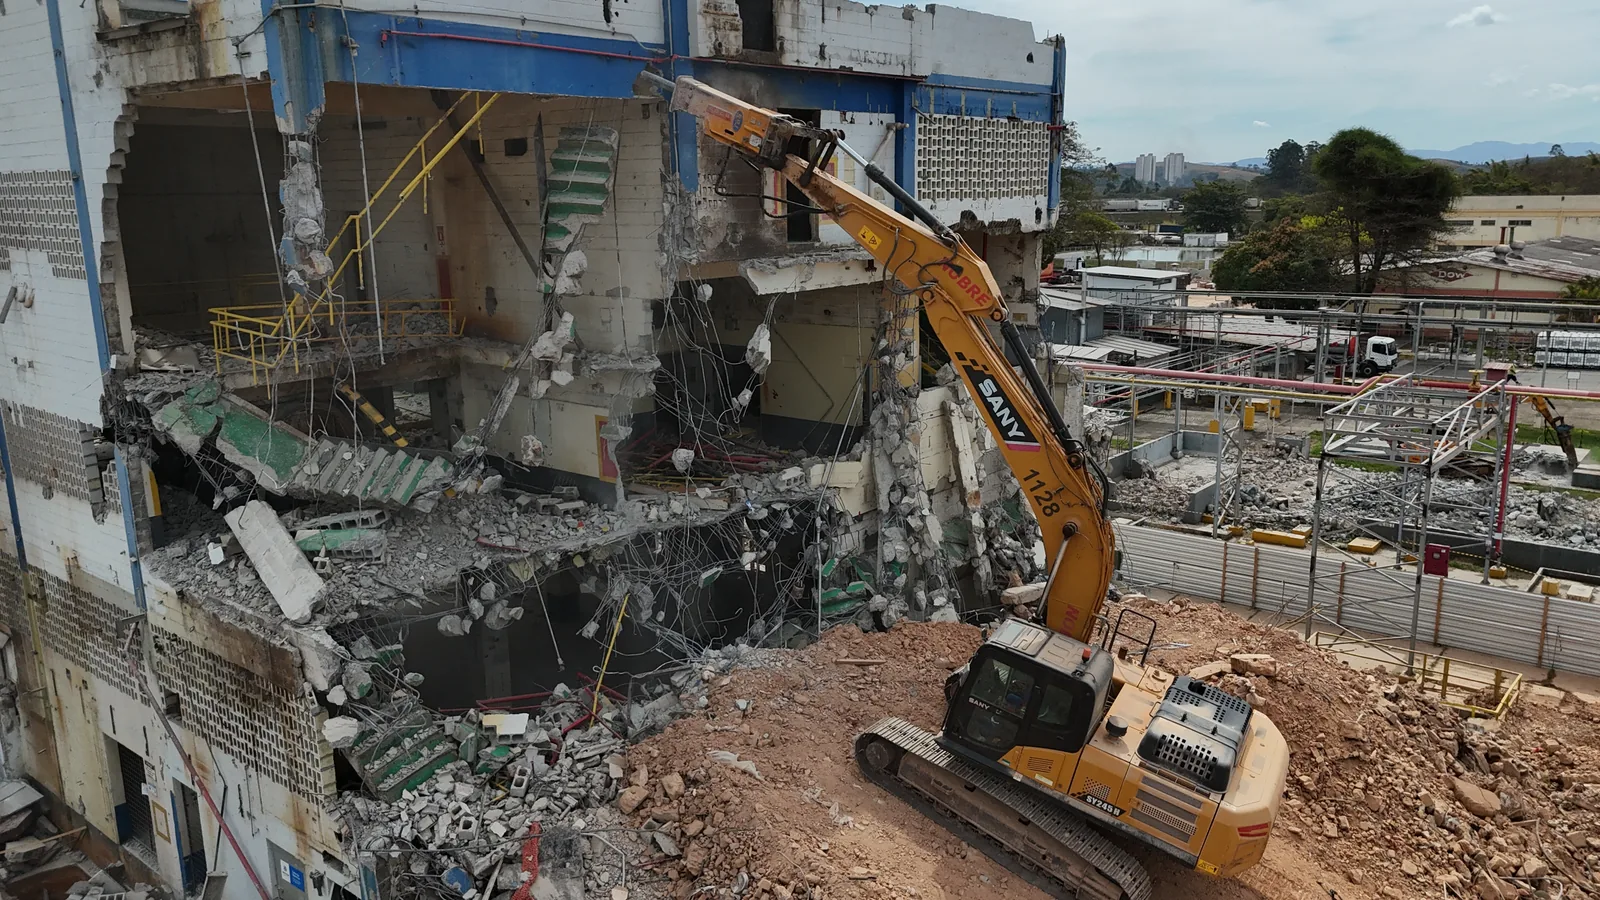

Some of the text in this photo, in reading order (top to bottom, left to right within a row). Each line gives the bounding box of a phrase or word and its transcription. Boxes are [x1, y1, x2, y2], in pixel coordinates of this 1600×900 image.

[978, 378, 1025, 438] SANY
[1023, 469, 1060, 517] 1128
[968, 697, 990, 710] SANY
